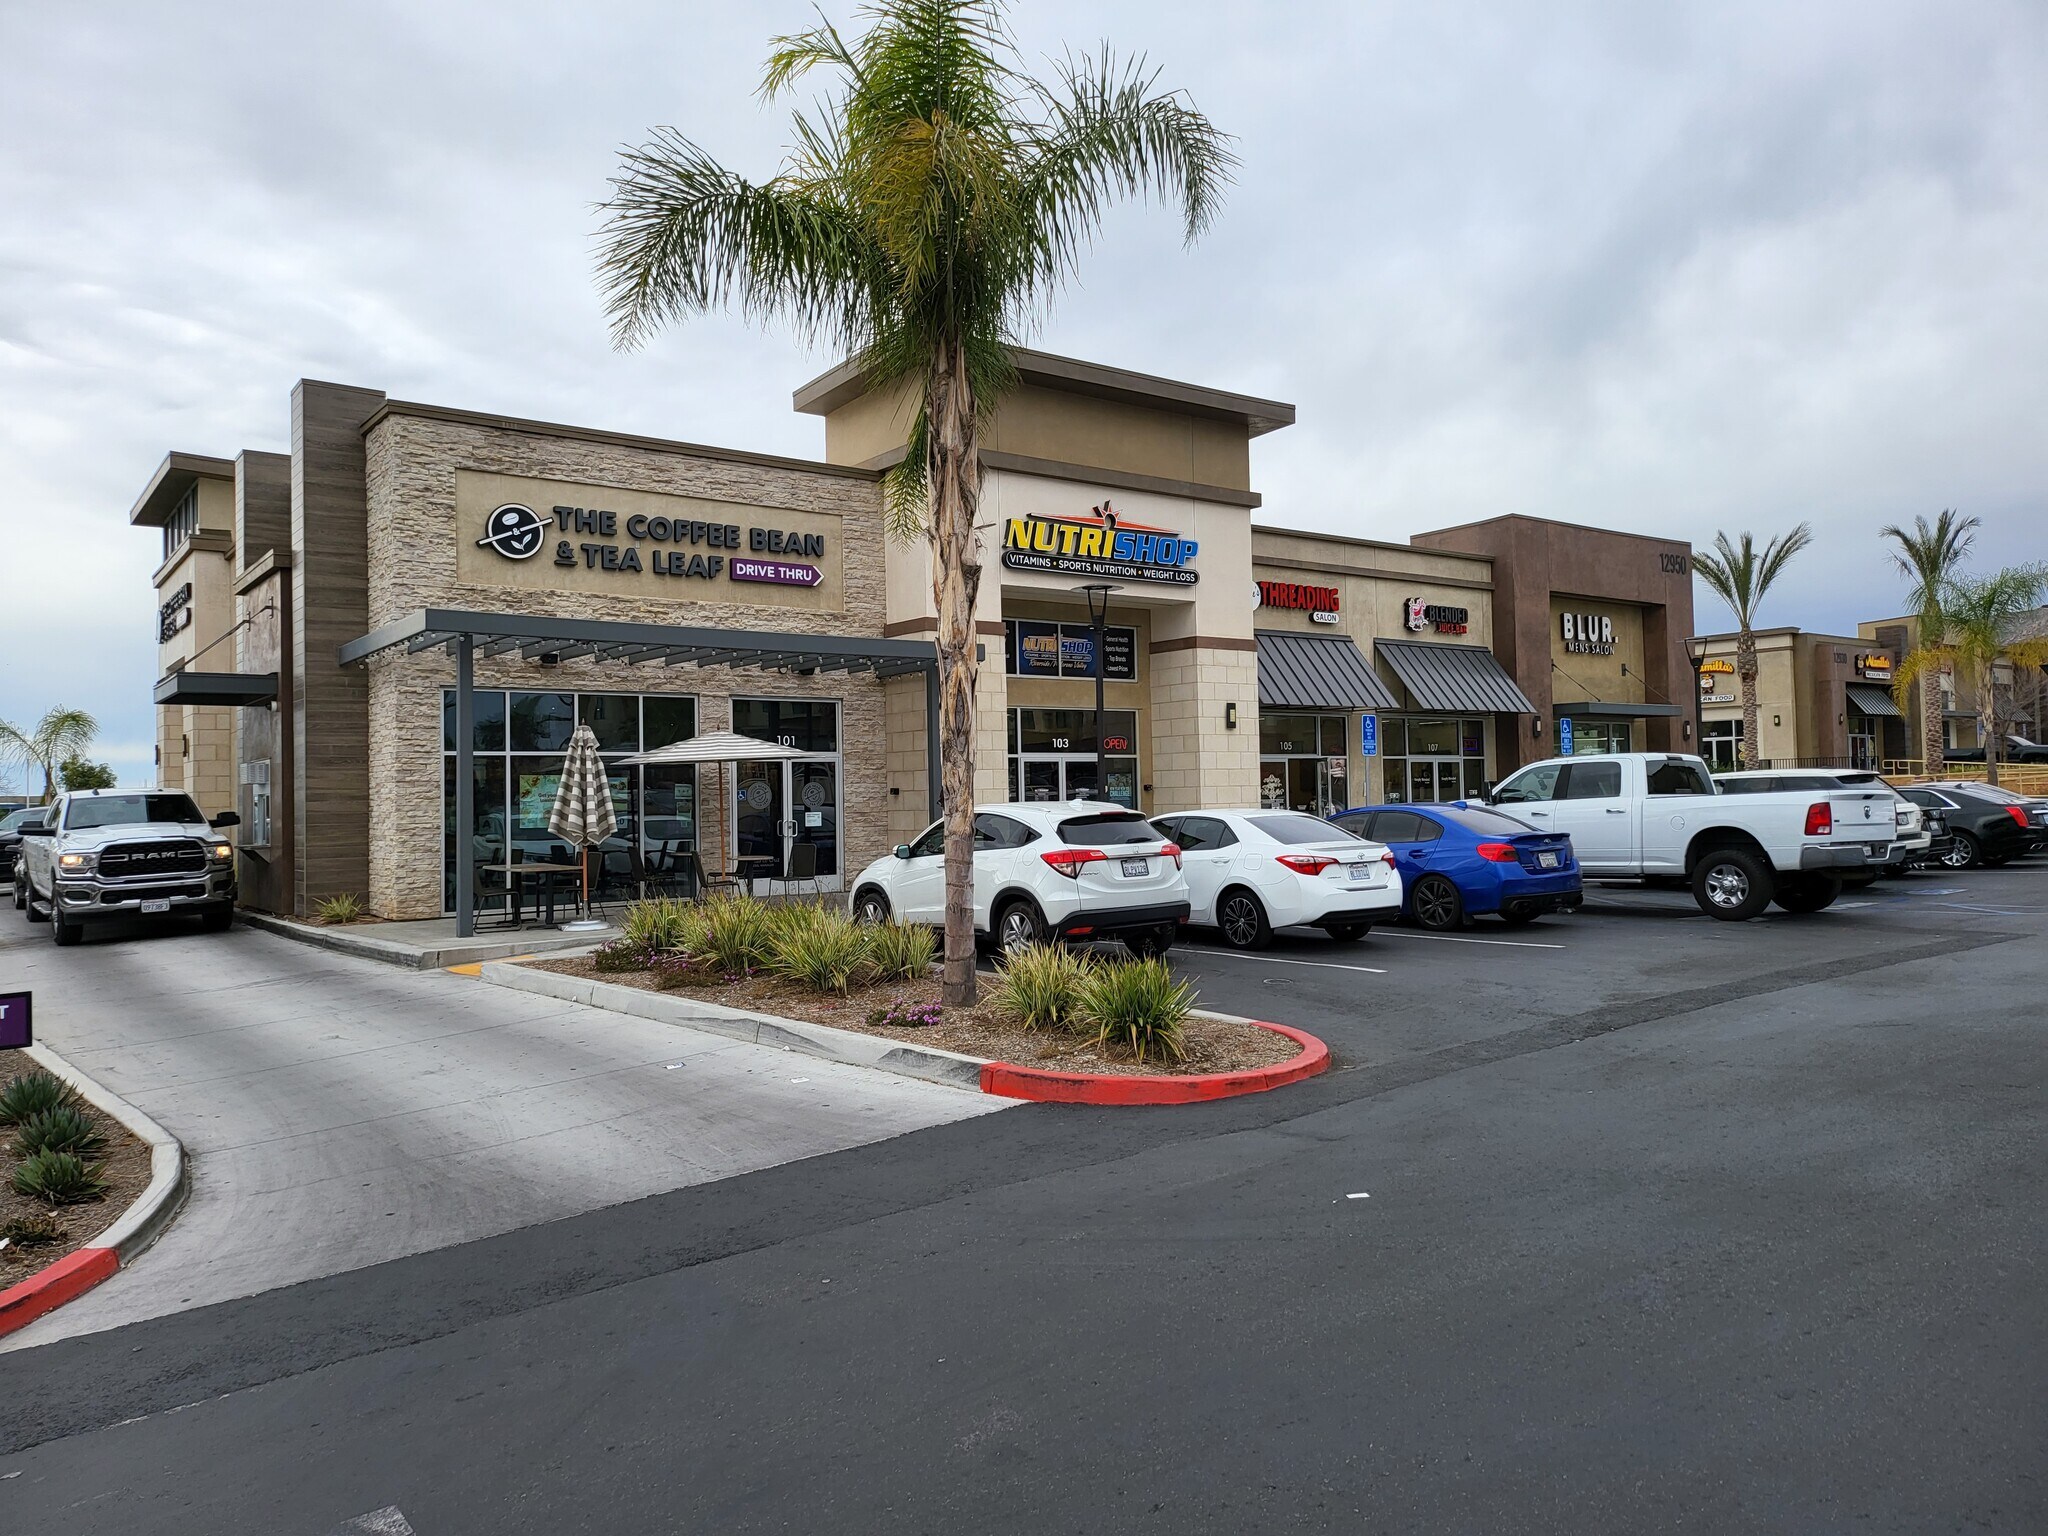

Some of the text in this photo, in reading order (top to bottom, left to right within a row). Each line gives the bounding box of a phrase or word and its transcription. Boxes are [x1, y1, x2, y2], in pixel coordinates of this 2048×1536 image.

[553, 505, 824, 556] THE COFFEE BEAN
[1005, 518, 1199, 566] NUTRISHOP
[555, 541, 724, 578] & TEA LEAF
[1660, 553, 1687, 575] 12950
[736, 563, 812, 581] DRIVE THRU
[1009, 554, 1195, 582] VITAMINS SPORTS NUTRITION WEIGHT LOSS
[1258, 580, 1340, 612] THREADING
[1315, 613, 1337, 622] SALON
[1567, 642, 1616, 656] MENS SALON
[776, 735, 796, 747] 101
[1052, 738, 1069, 749] 103
[1103, 738, 1127, 750] OPEN
[1280, 741, 1293, 751] 105
[1427, 744, 1439, 752] 107
[131, 851, 176, 861] RAM
